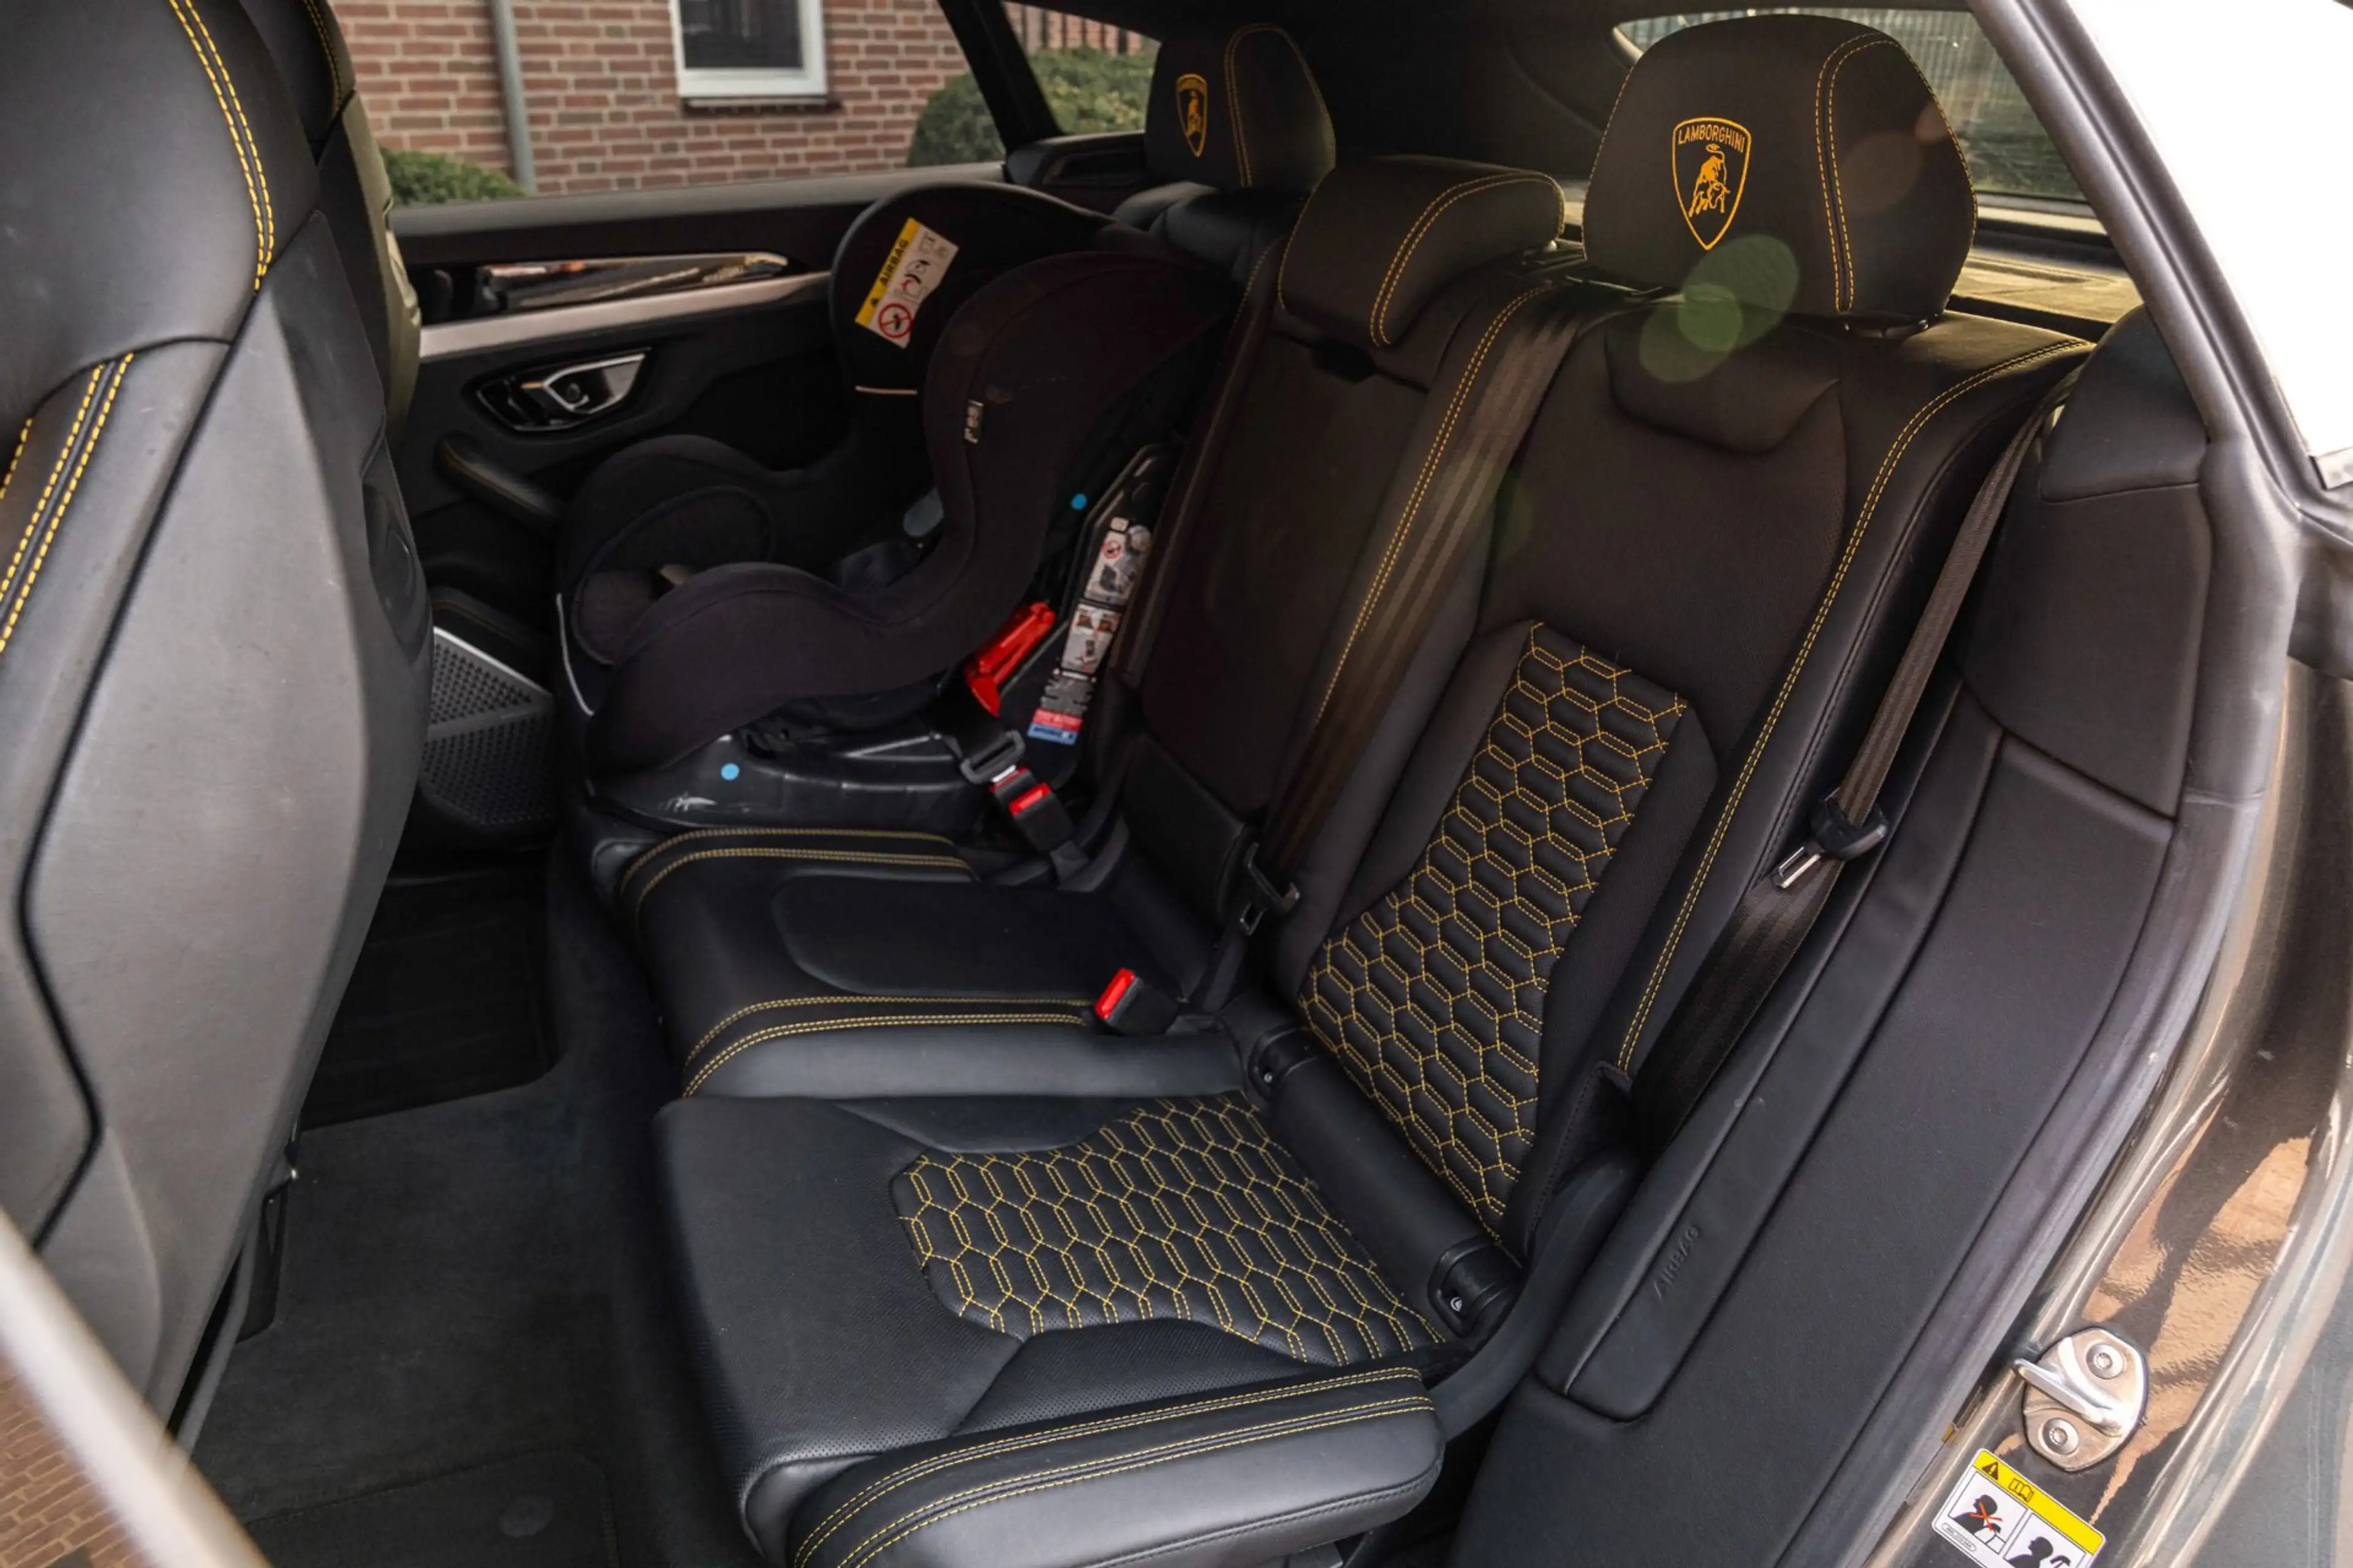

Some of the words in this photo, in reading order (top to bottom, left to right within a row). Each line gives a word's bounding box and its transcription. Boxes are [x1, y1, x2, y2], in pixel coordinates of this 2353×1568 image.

[1678, 124, 1745, 153] LAMBORGHINI
[880, 240, 909, 287] AIRBAG
[1653, 1225, 1700, 1301] AIRBAG
